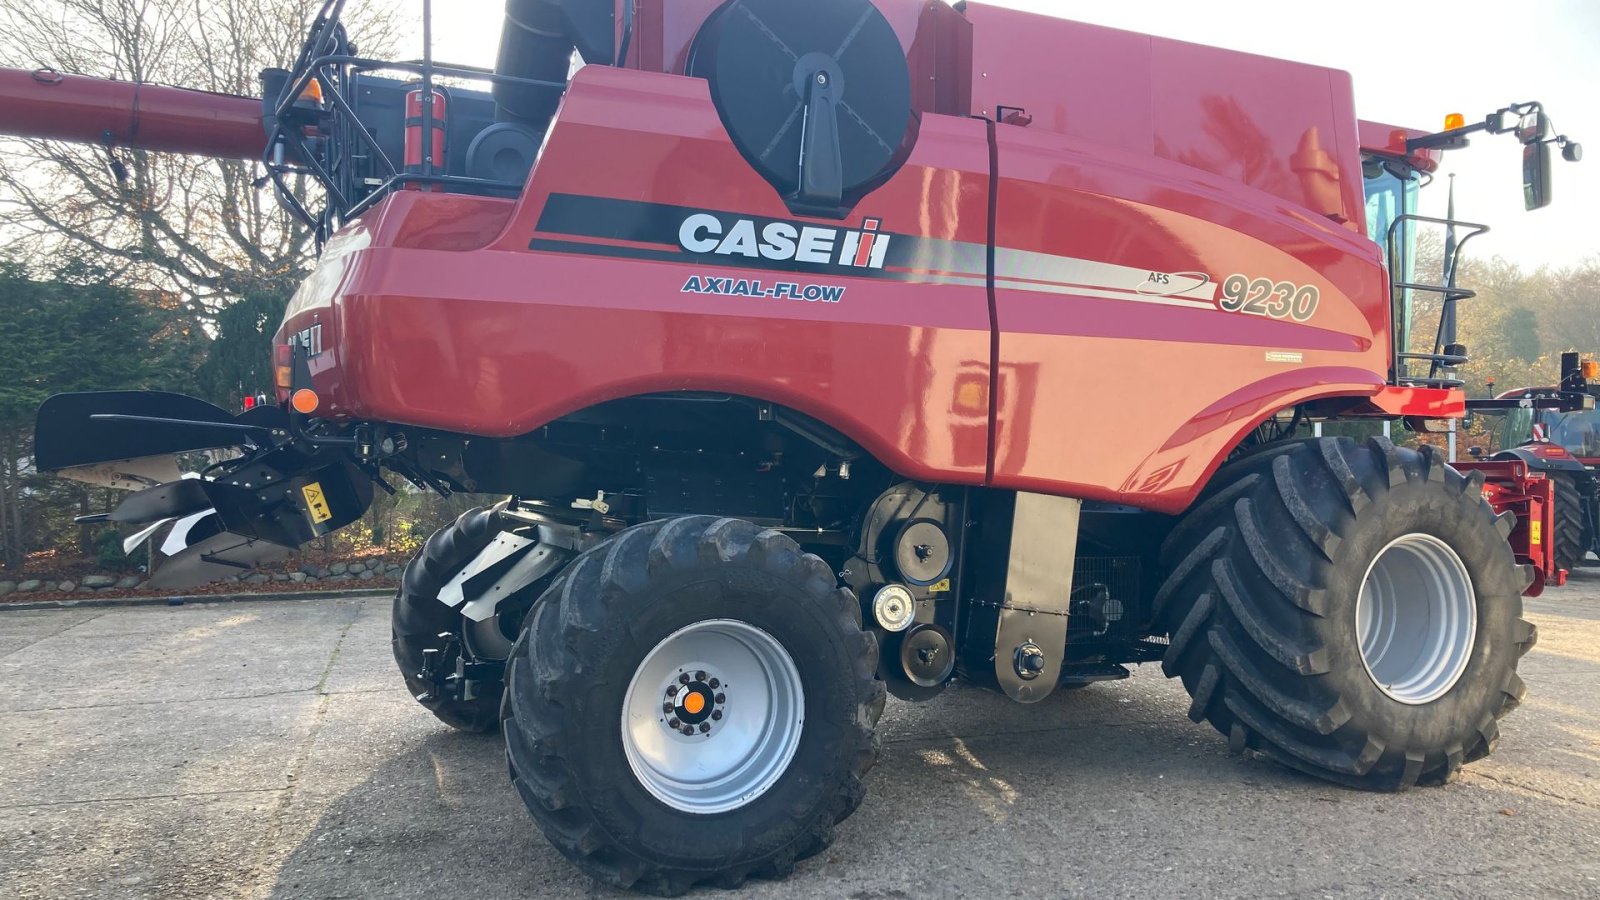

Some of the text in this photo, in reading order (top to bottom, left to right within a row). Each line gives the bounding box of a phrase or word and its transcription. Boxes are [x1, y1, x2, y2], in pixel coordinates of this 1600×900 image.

[678, 213, 837, 264] CASE
[681, 275, 845, 303] AXIAL-FLOW
[1148, 272, 1170, 285] AFS
[1219, 273, 1320, 322] 9230
